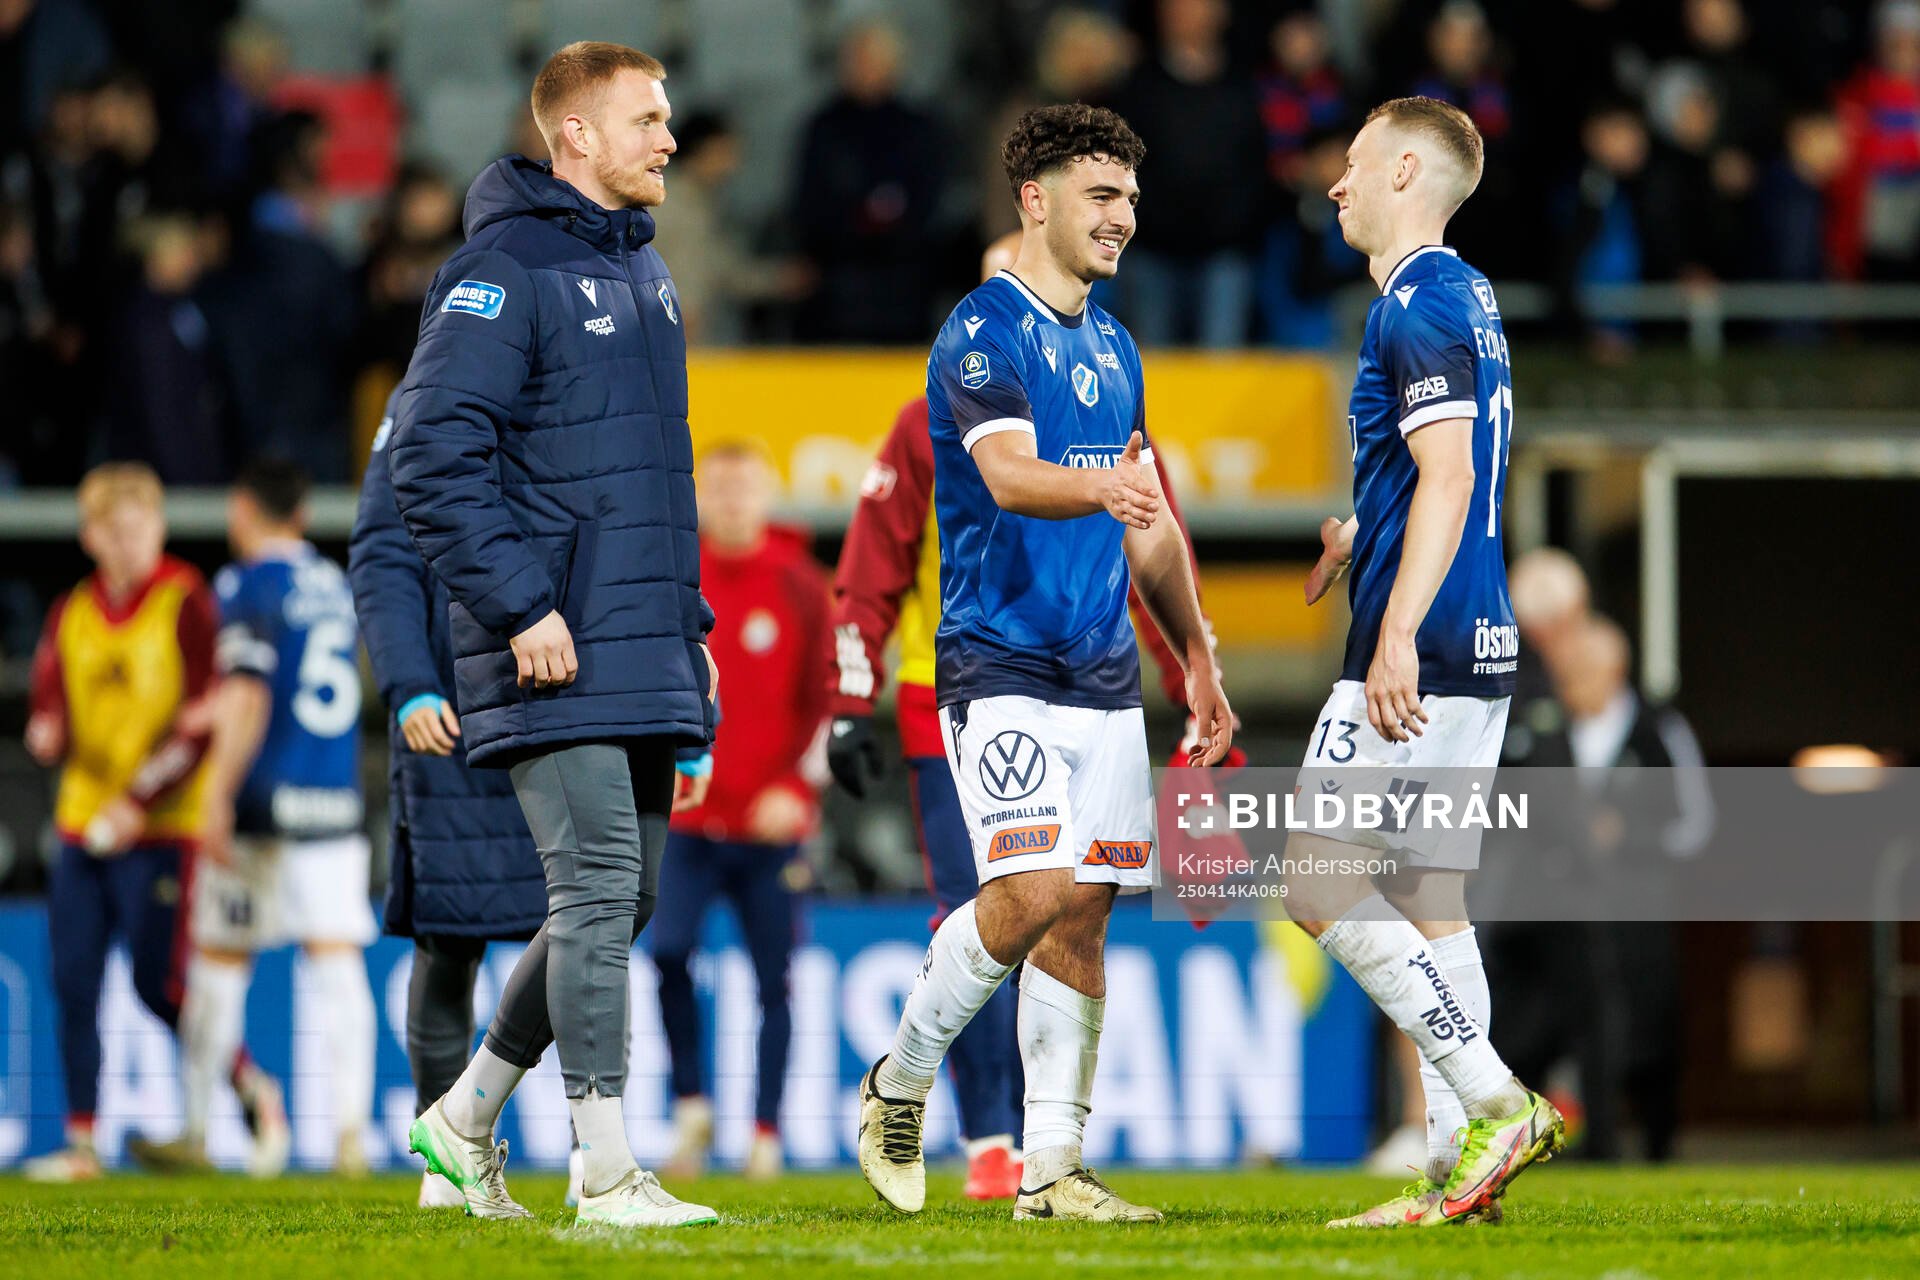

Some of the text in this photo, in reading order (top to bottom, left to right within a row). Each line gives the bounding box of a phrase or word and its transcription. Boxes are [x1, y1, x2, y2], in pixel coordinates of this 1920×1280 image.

[584, 314, 613, 333] sport
[1406, 376, 1449, 404] HFAB
[1316, 717, 1361, 763] 13
[981, 806, 1058, 828] MOTORHALLAND
[996, 830, 1050, 853] JONAB
[1096, 844, 1143, 863] JONAB
[1407, 949, 1478, 1046] Transport
[1419, 1006, 1455, 1041] GN
